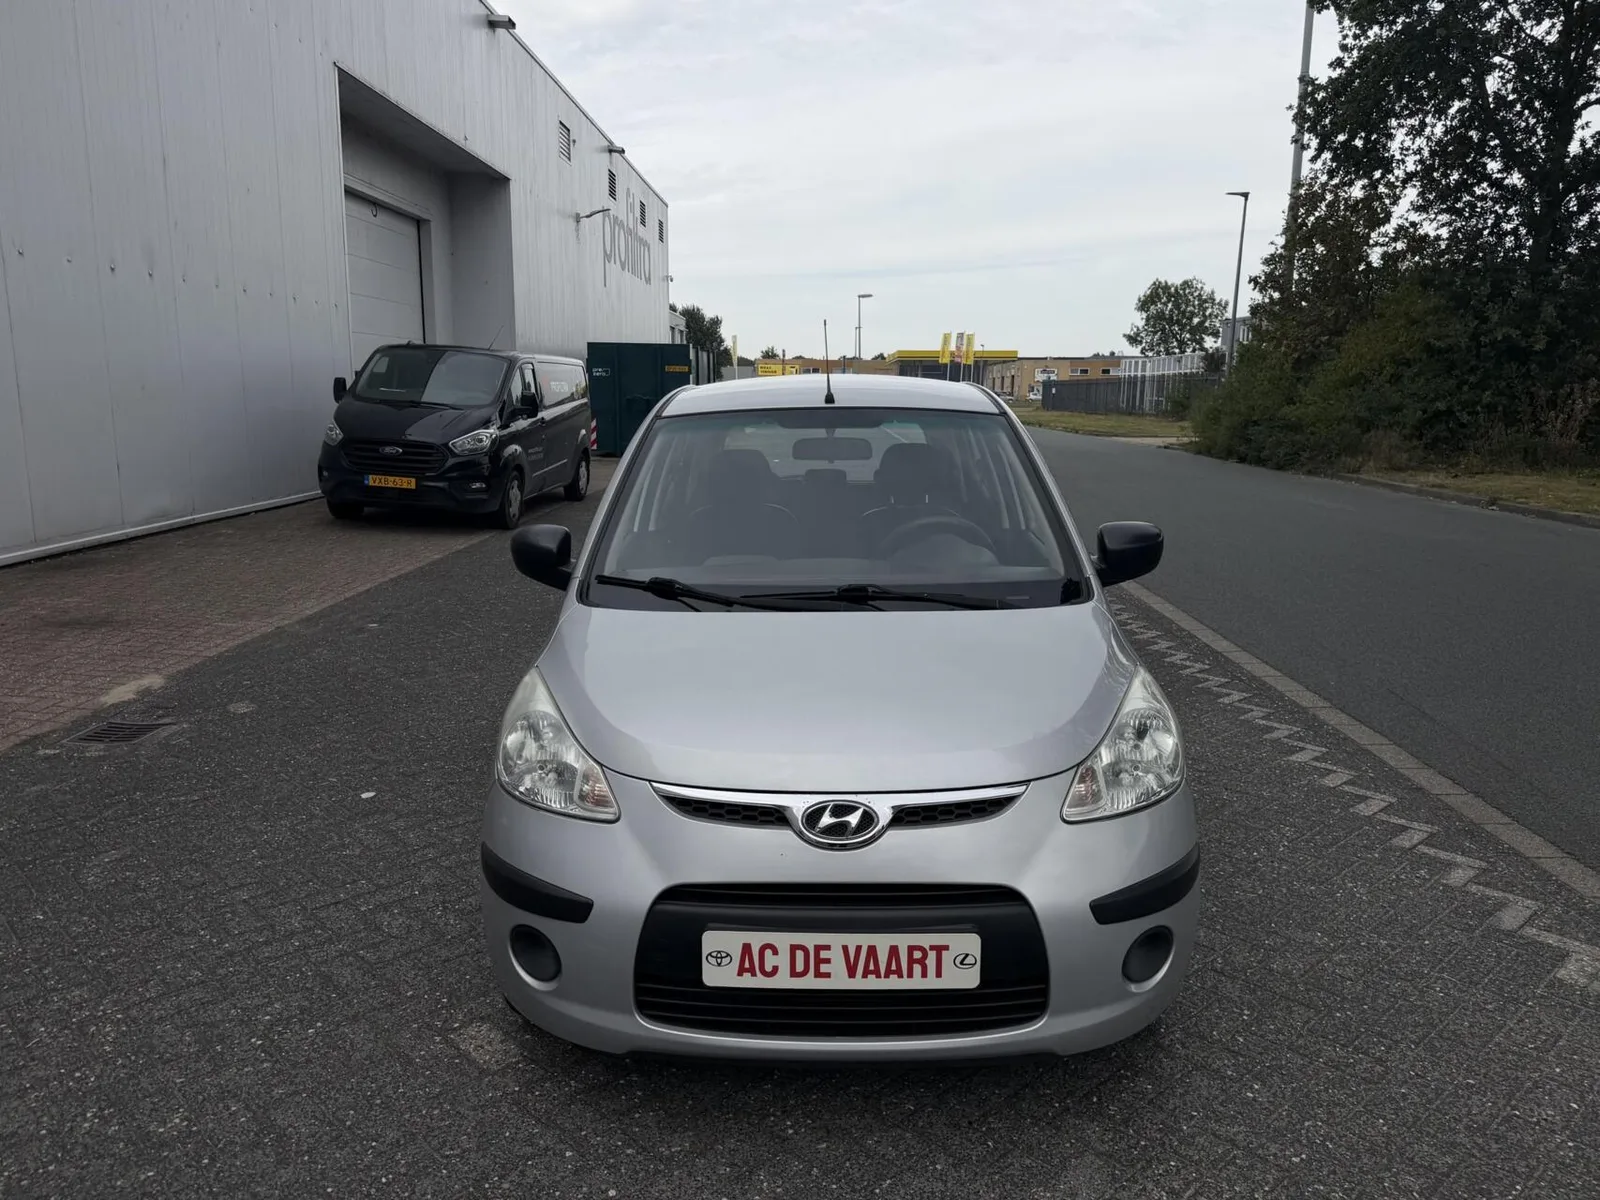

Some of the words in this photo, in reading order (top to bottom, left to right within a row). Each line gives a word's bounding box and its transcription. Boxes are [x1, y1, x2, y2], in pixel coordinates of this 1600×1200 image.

[371, 476, 413, 488] VXB-63-R
[737, 942, 779, 978] AC
[789, 943, 832, 979] DE
[842, 944, 950, 979] VAART
